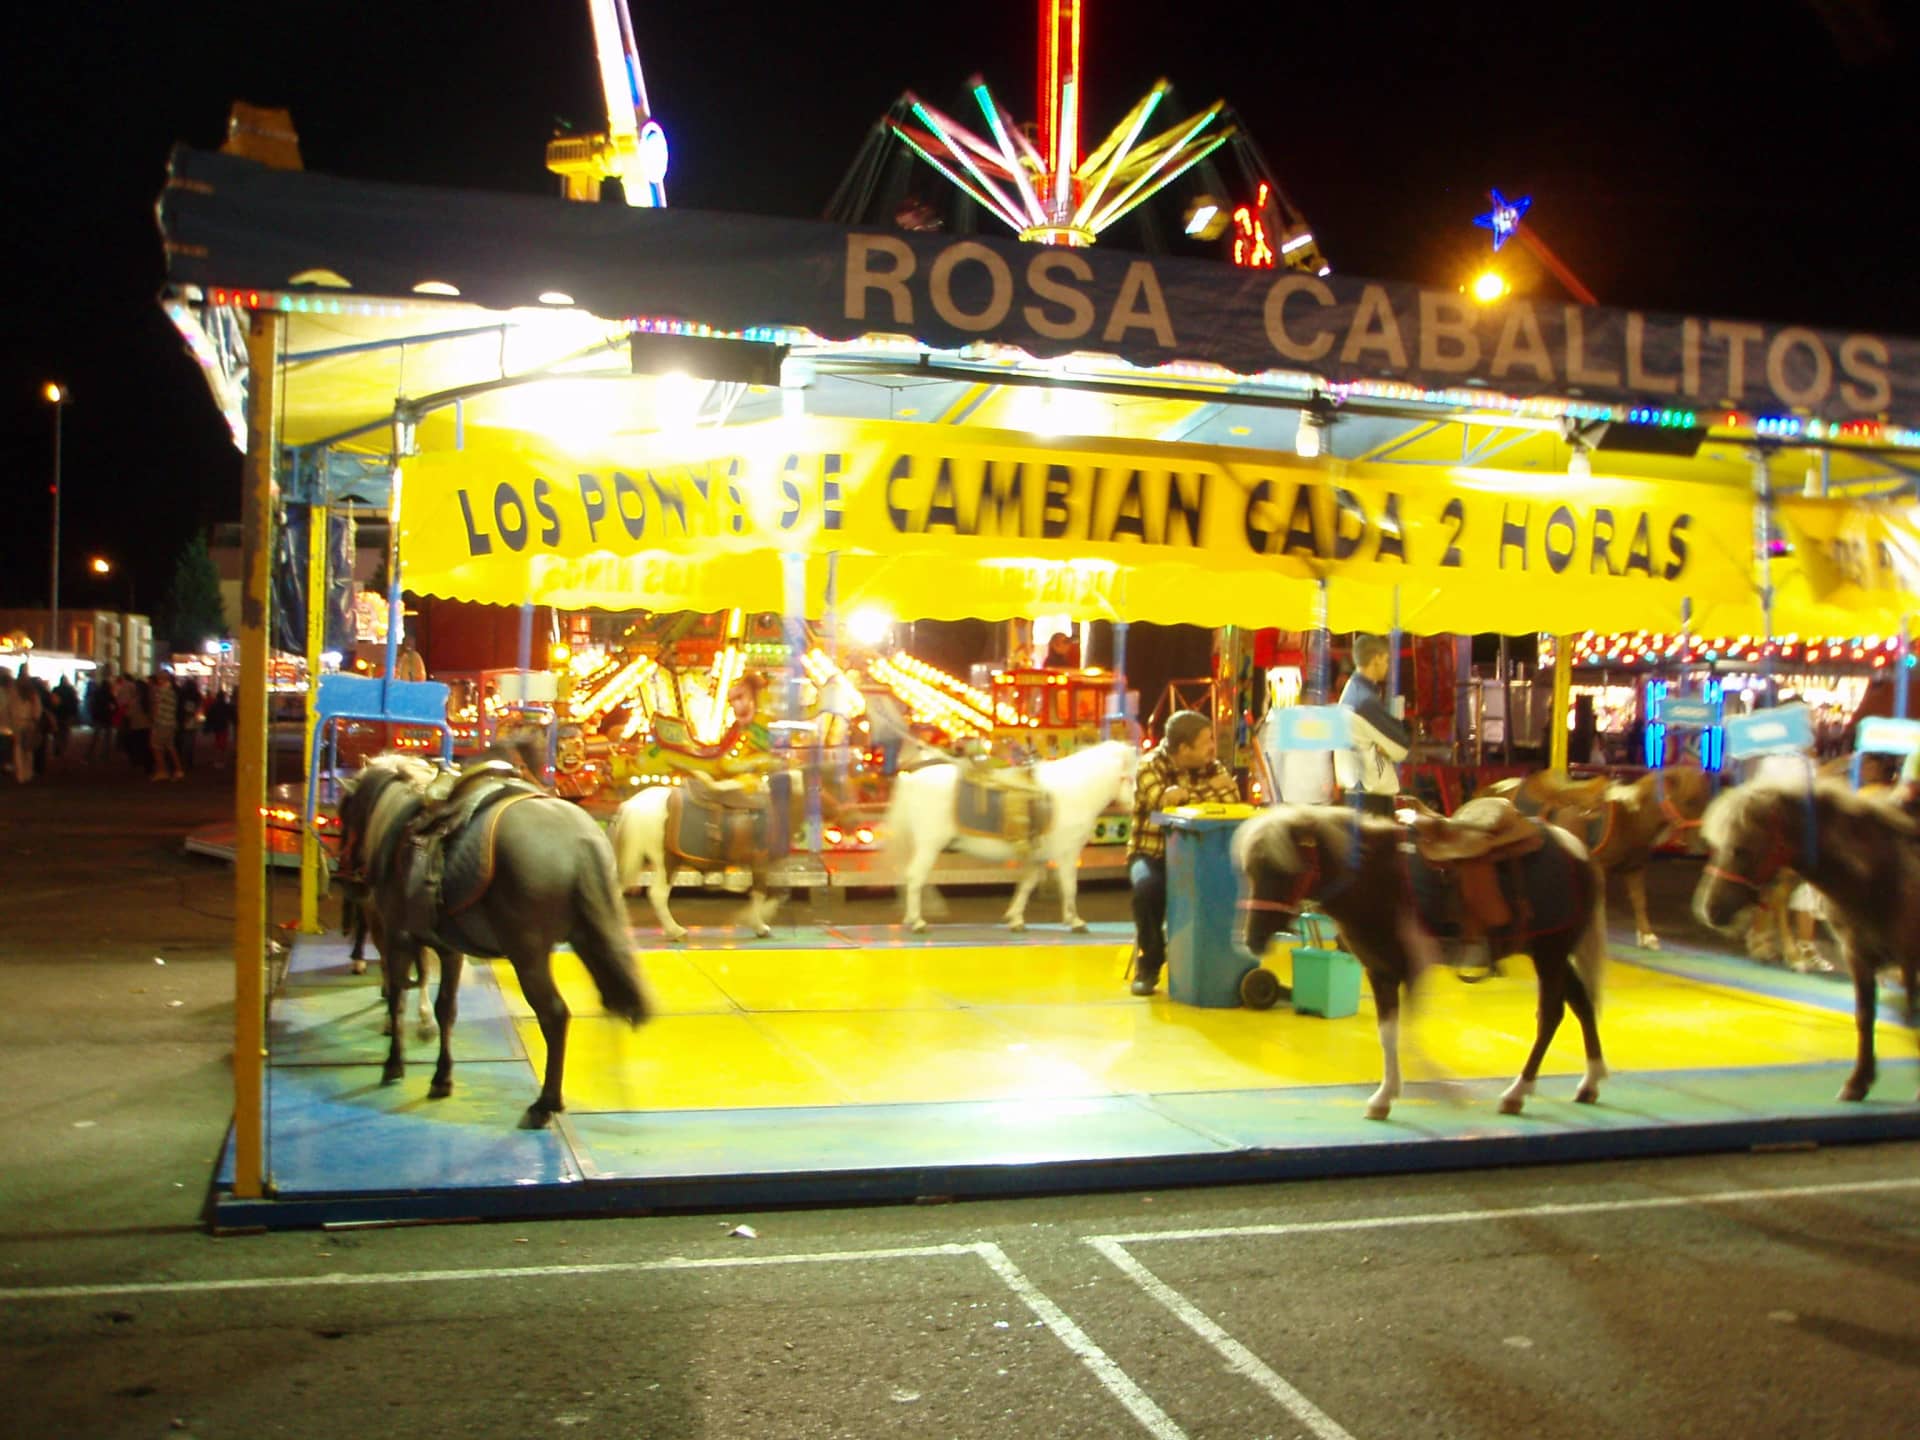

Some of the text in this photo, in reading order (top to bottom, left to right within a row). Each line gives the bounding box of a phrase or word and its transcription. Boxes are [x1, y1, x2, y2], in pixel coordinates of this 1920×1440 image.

[843, 232, 1893, 416] ROSA CABALLITOS
[458, 476, 560, 556] LOS
[781, 453, 842, 531] SE
[886, 454, 1208, 547] CAMBIAN
[1245, 479, 1408, 563] CADA
[1439, 498, 1463, 567] 2
[1500, 502, 1695, 581] HORAS
